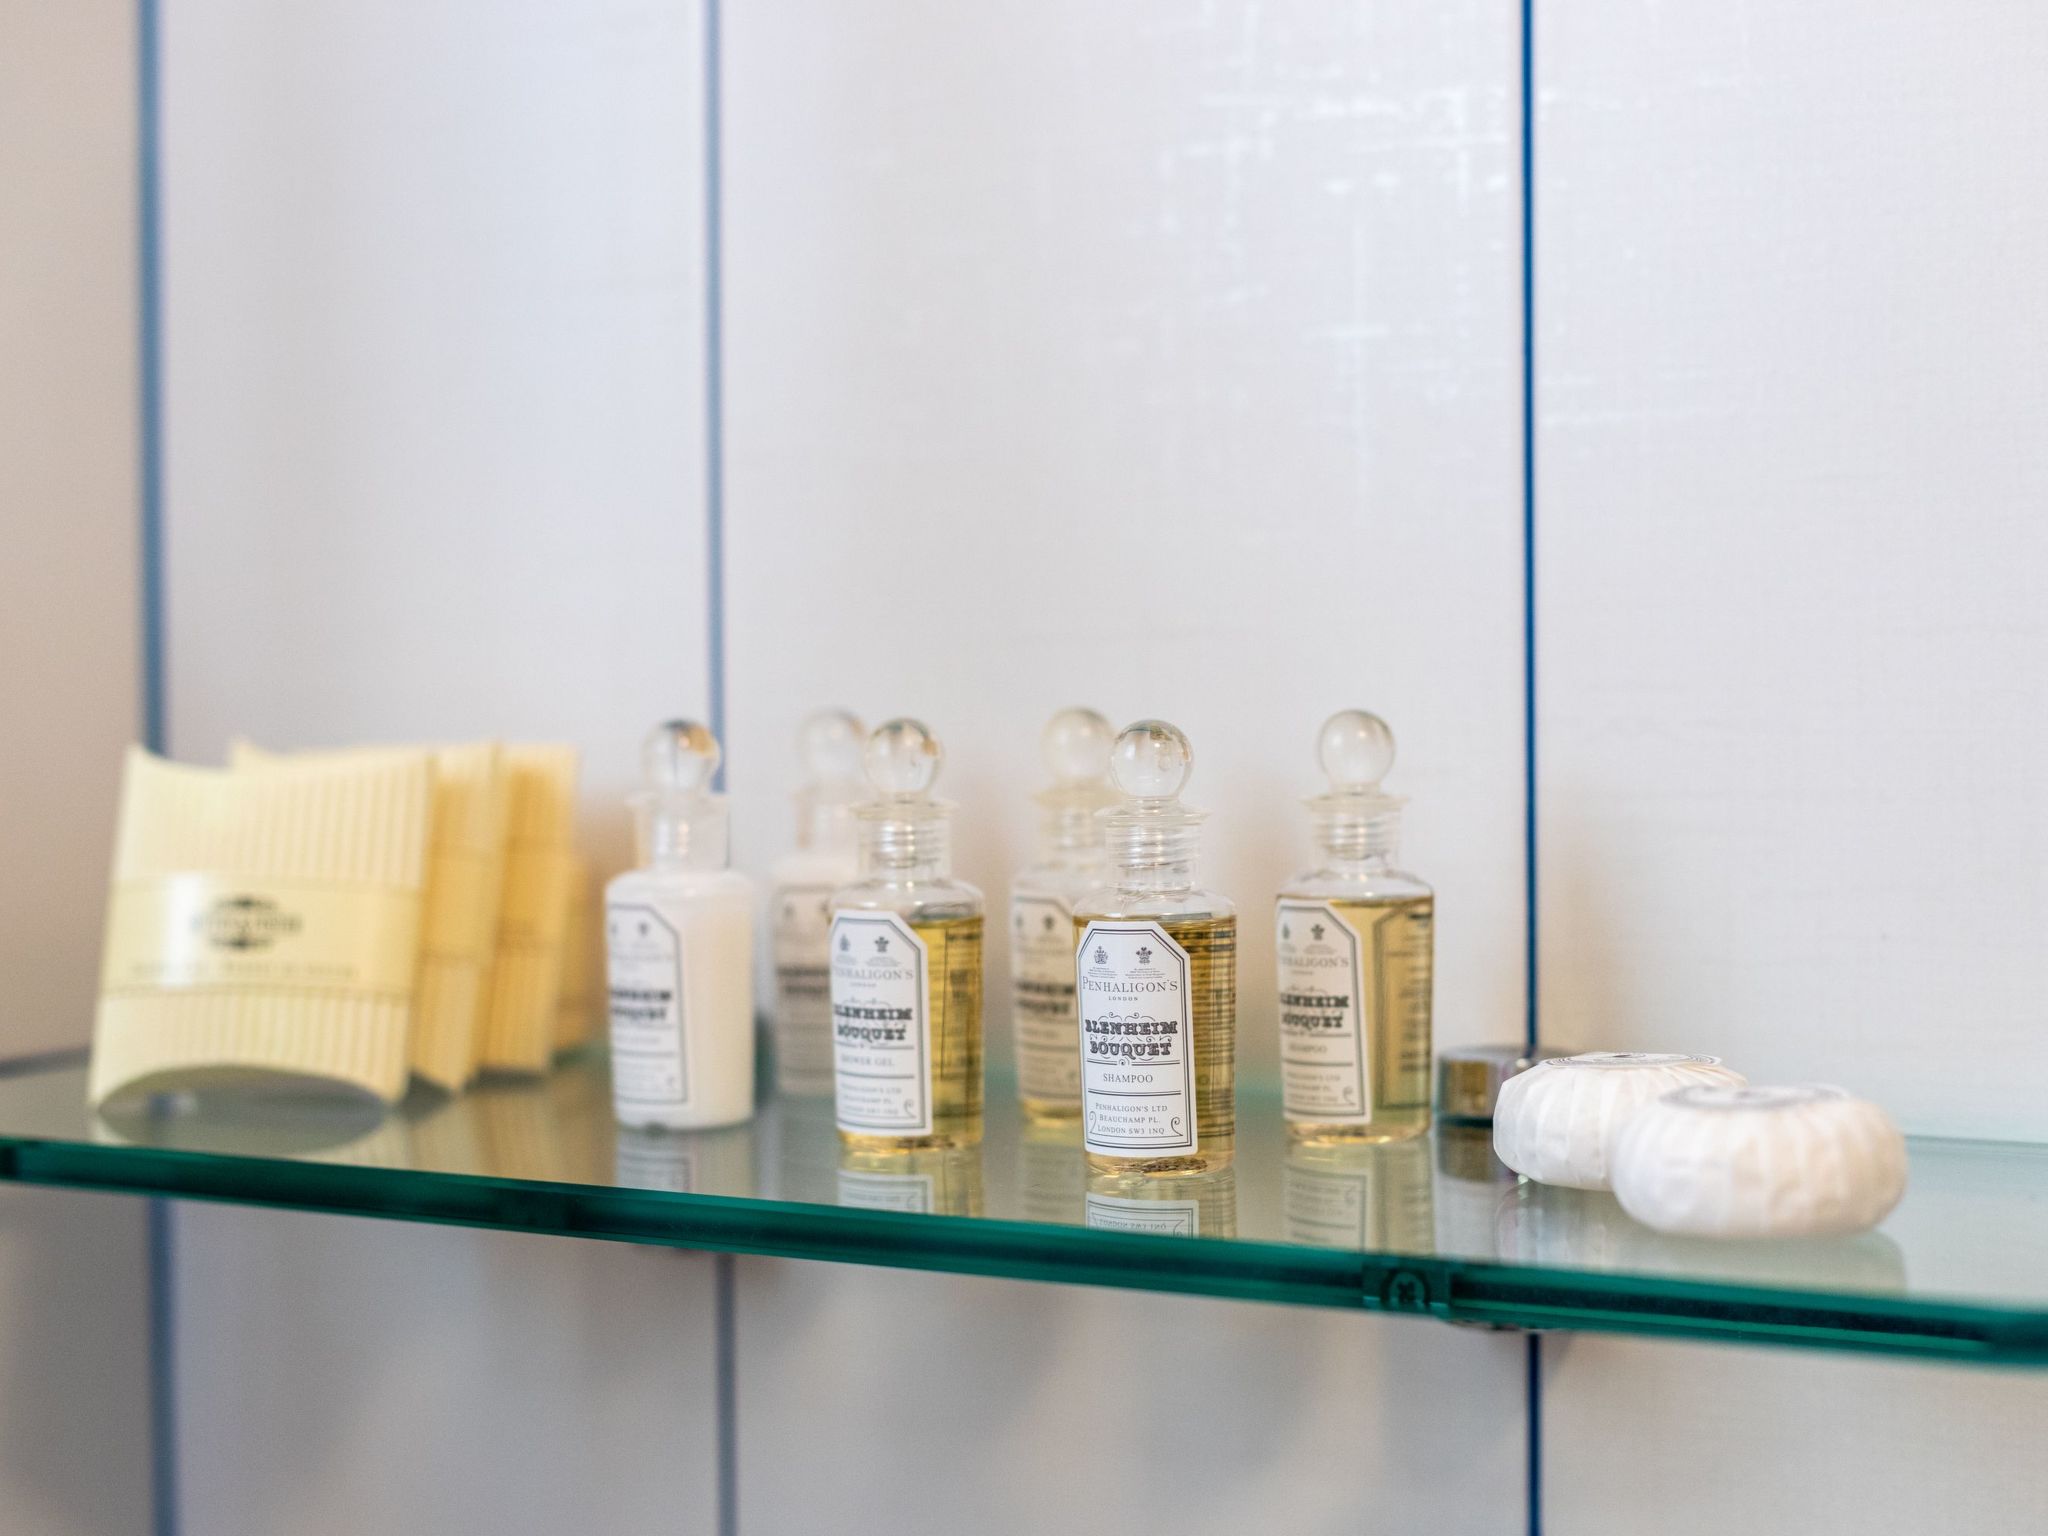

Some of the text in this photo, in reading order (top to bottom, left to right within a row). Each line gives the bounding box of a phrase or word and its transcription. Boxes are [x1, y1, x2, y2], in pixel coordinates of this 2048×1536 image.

[1082, 976, 1178, 993] PENHALIGON'S
[1085, 1019, 1178, 1036] BLENHEIM
[1089, 1040, 1172, 1060] BOUQUET
[1103, 1073, 1154, 1084] SHAMPOO
[1095, 1102, 1149, 1112] PENHALIGON'S
[1099, 1113, 1146, 1124] BEAUCHAMP
[1097, 1124, 1165, 1135] LONDON SW3 1NQ
